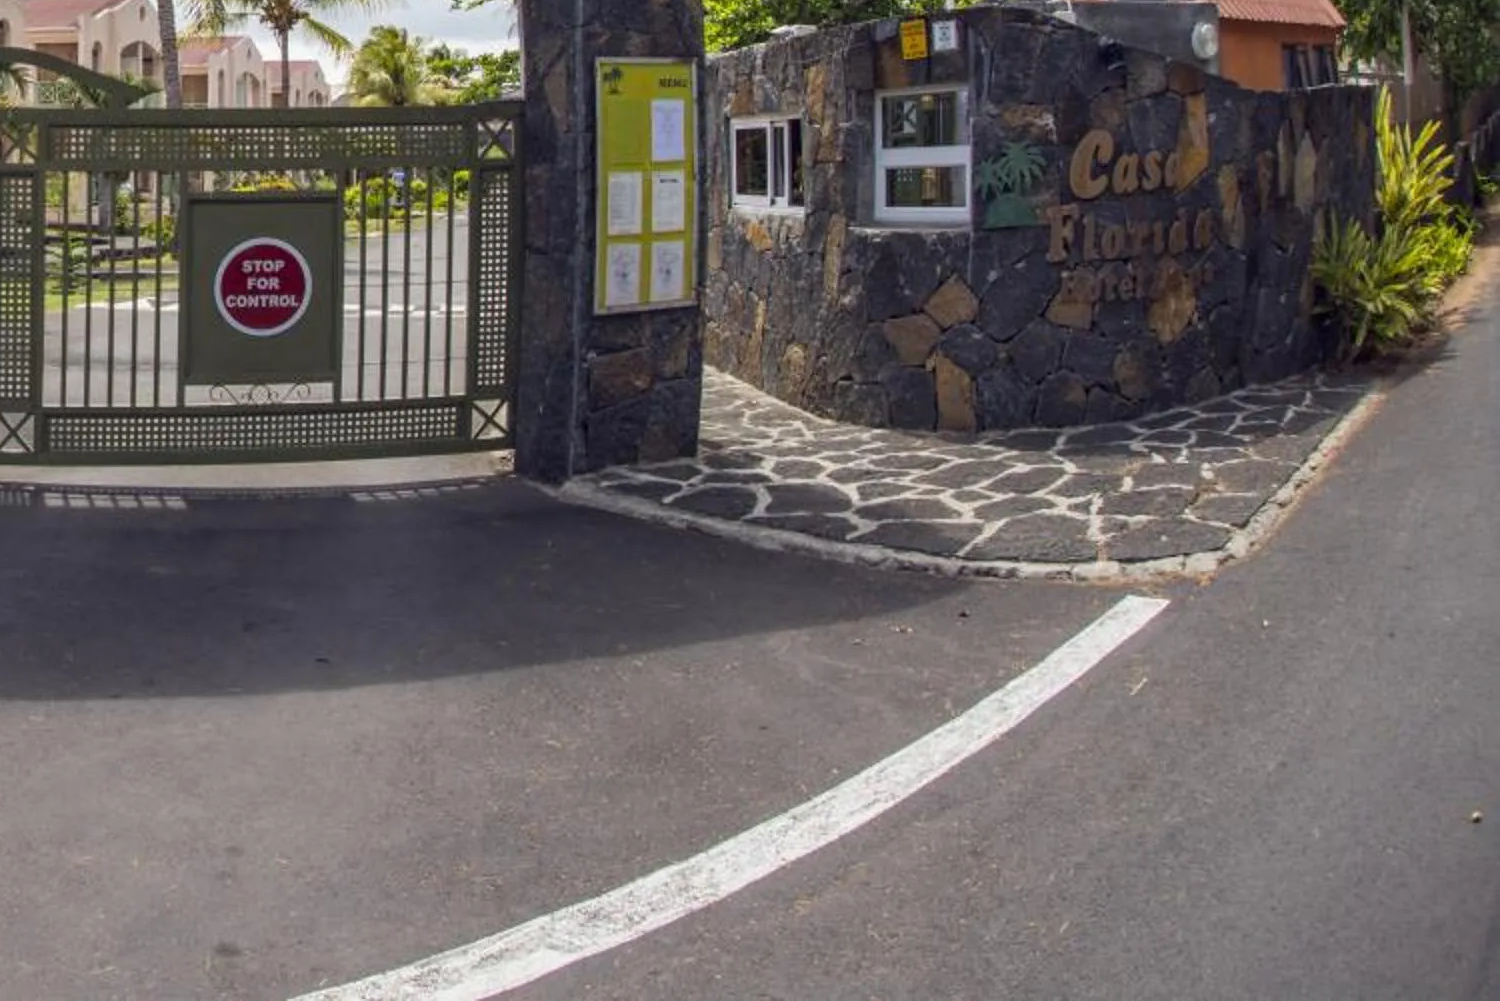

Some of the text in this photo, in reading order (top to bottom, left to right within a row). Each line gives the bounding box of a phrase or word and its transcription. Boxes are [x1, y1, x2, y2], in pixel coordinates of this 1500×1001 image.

[242, 259, 285, 274] STOP
[247, 277, 280, 290] FOR
[226, 294, 299, 308] CONTROL
